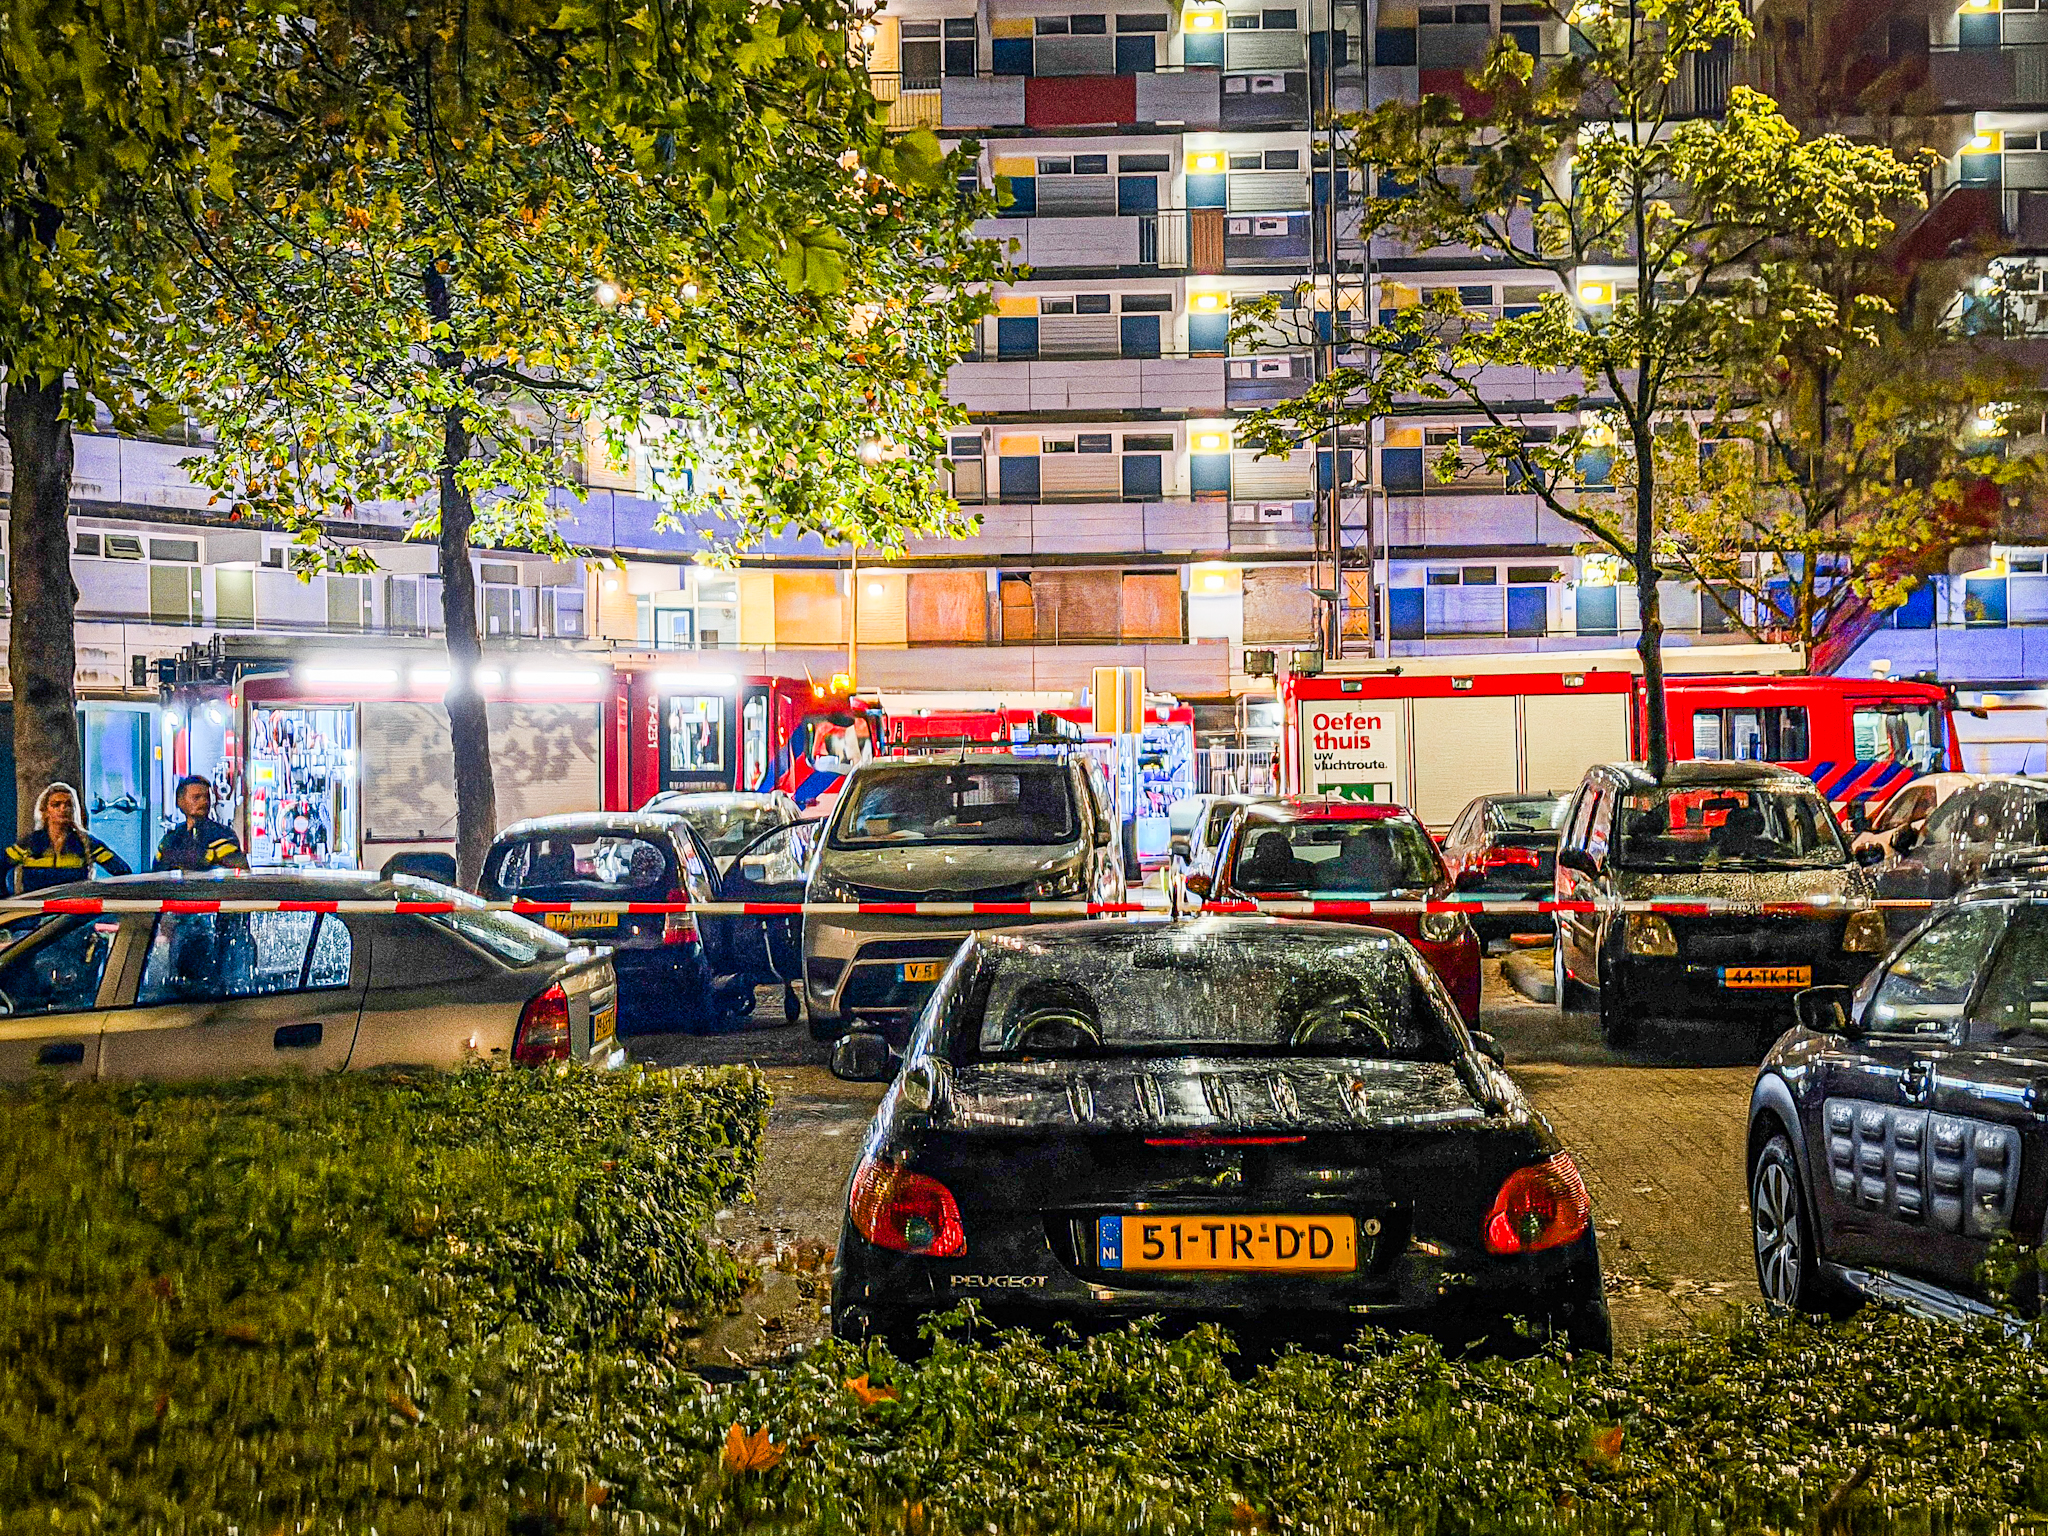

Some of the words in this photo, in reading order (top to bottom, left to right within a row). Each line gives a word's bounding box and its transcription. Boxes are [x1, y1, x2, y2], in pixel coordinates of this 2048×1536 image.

[1313, 712, 1382, 731] Oefen
[1313, 731, 1371, 750] thuis
[1314, 752, 1334, 761] uw
[1733, 969, 1806, 985] 44-TK-FL
[1102, 1246, 1119, 1260] NL
[1142, 1223, 1334, 1260] 51-TR-DD
[950, 1274, 1049, 1288] PEUGEOT
